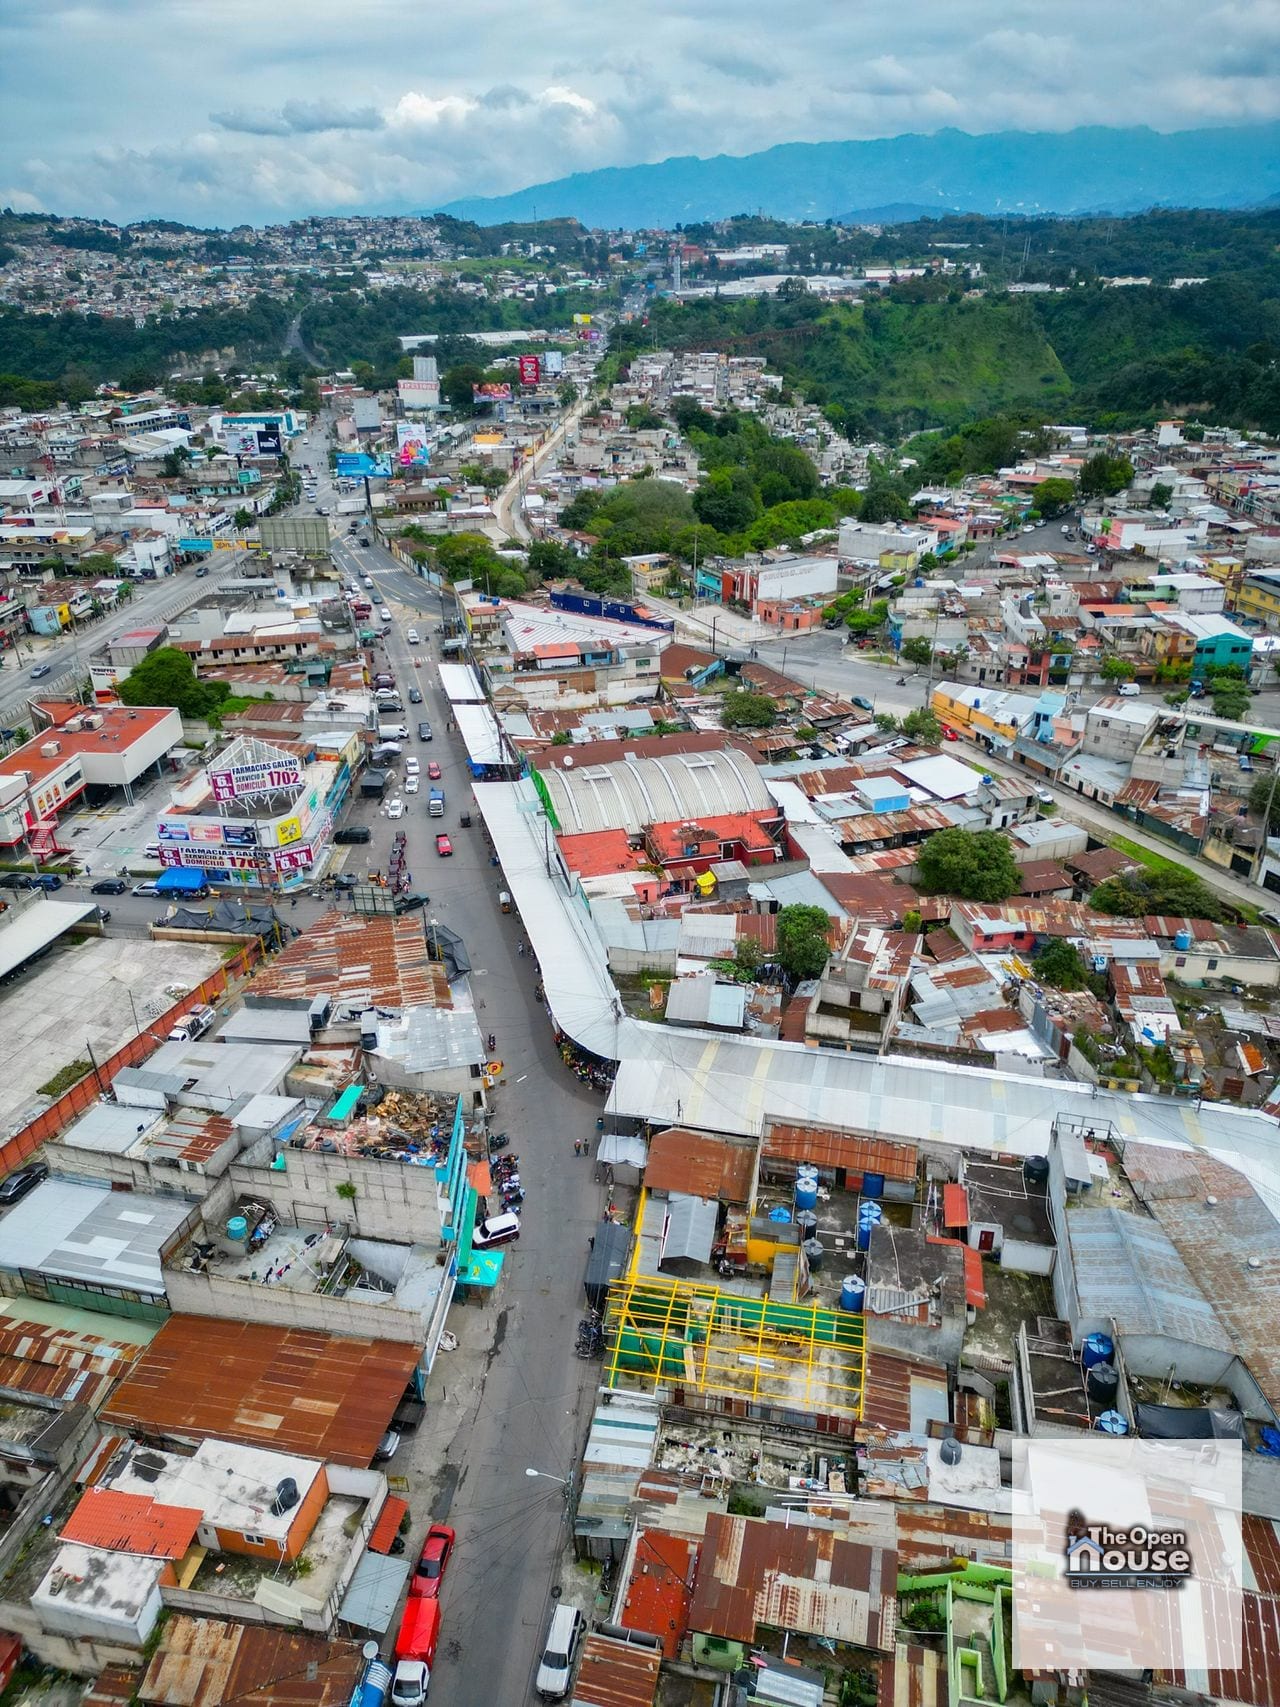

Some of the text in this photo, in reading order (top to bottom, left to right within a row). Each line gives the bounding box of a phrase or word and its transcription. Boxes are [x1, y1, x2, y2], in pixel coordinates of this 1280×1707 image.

[232, 762, 271, 775] FARMACIAS
[272, 758, 297, 769] GALENO
[235, 774, 260, 783] SERVICIO
[268, 771, 299, 786] 1702
[236, 780, 266, 792] DOMICILIO
[180, 847, 234, 856] FARMACIAS
[185, 858, 225, 866] DOMICILIO
